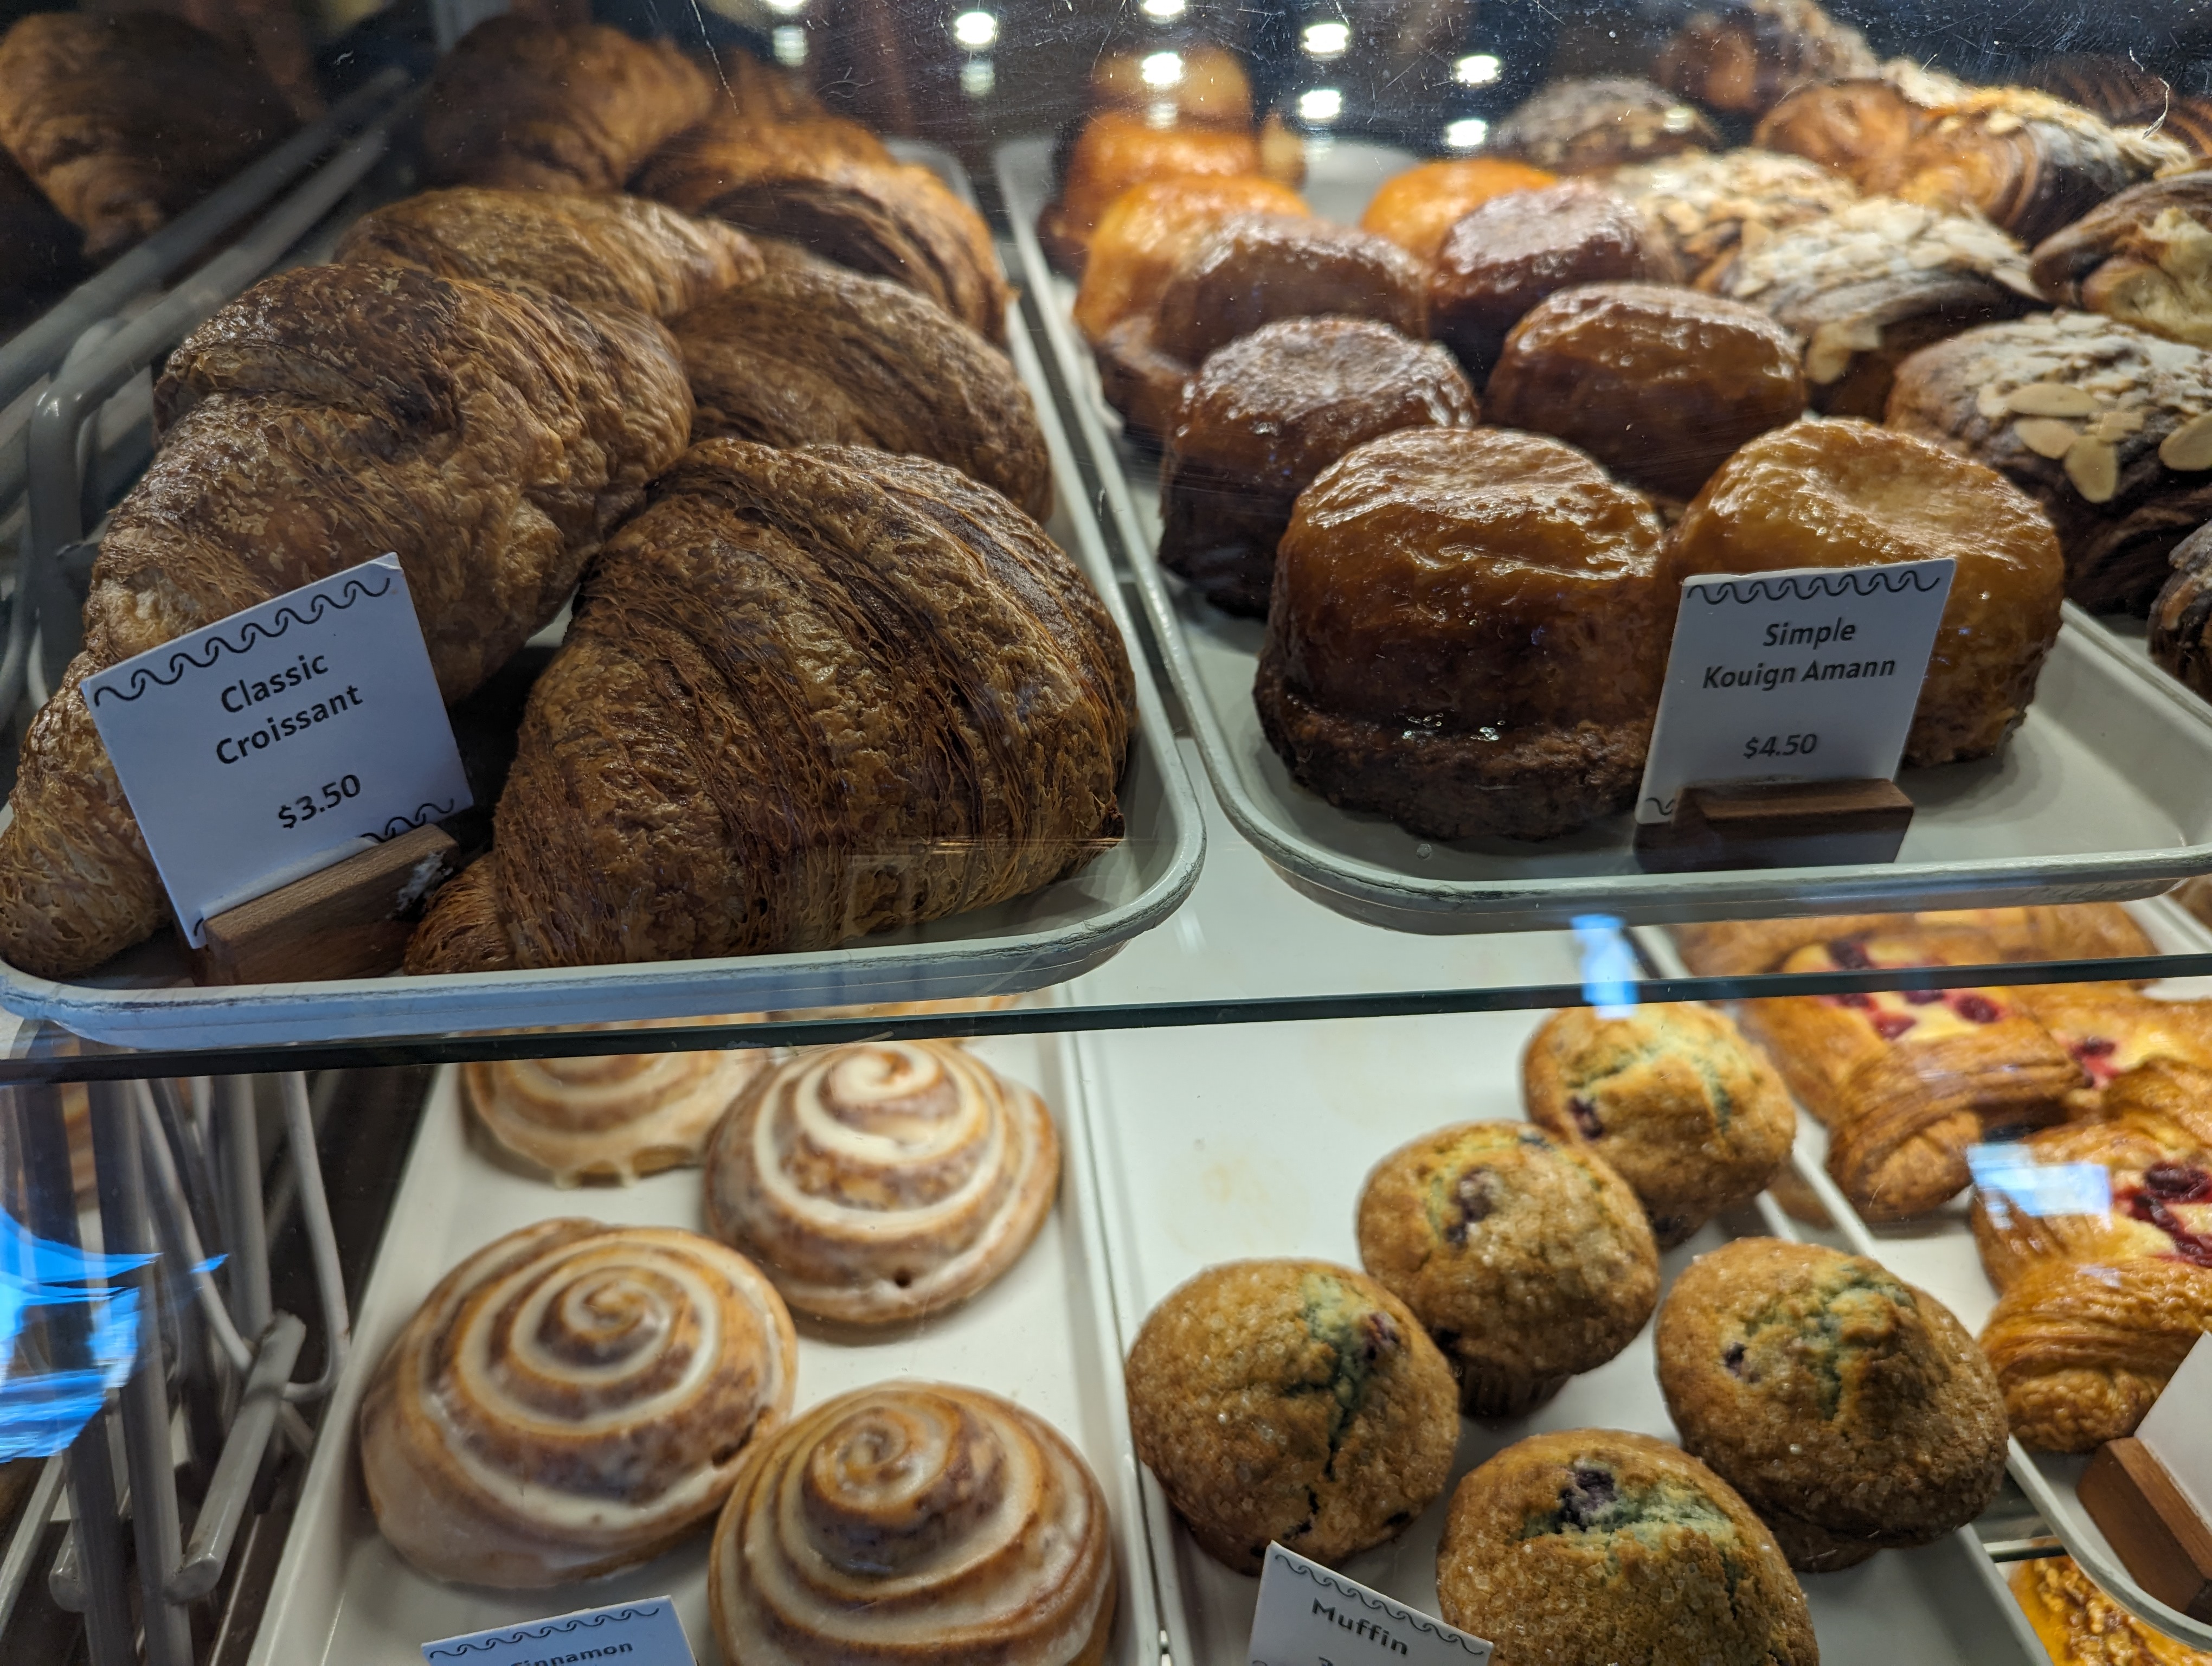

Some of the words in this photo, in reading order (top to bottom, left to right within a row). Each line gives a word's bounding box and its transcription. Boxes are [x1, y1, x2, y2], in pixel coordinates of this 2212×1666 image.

[1763, 617, 1856, 650] Simple
[221, 655, 329, 713] Classic
[1702, 662, 1796, 691] Kouign
[1800, 659, 1895, 682] Amann
[216, 684, 363, 765] Croissant
[1742, 733, 1818, 759] $4.50
[278, 774, 362, 829] $3.50
[1312, 1597, 1408, 1655] Muffin
